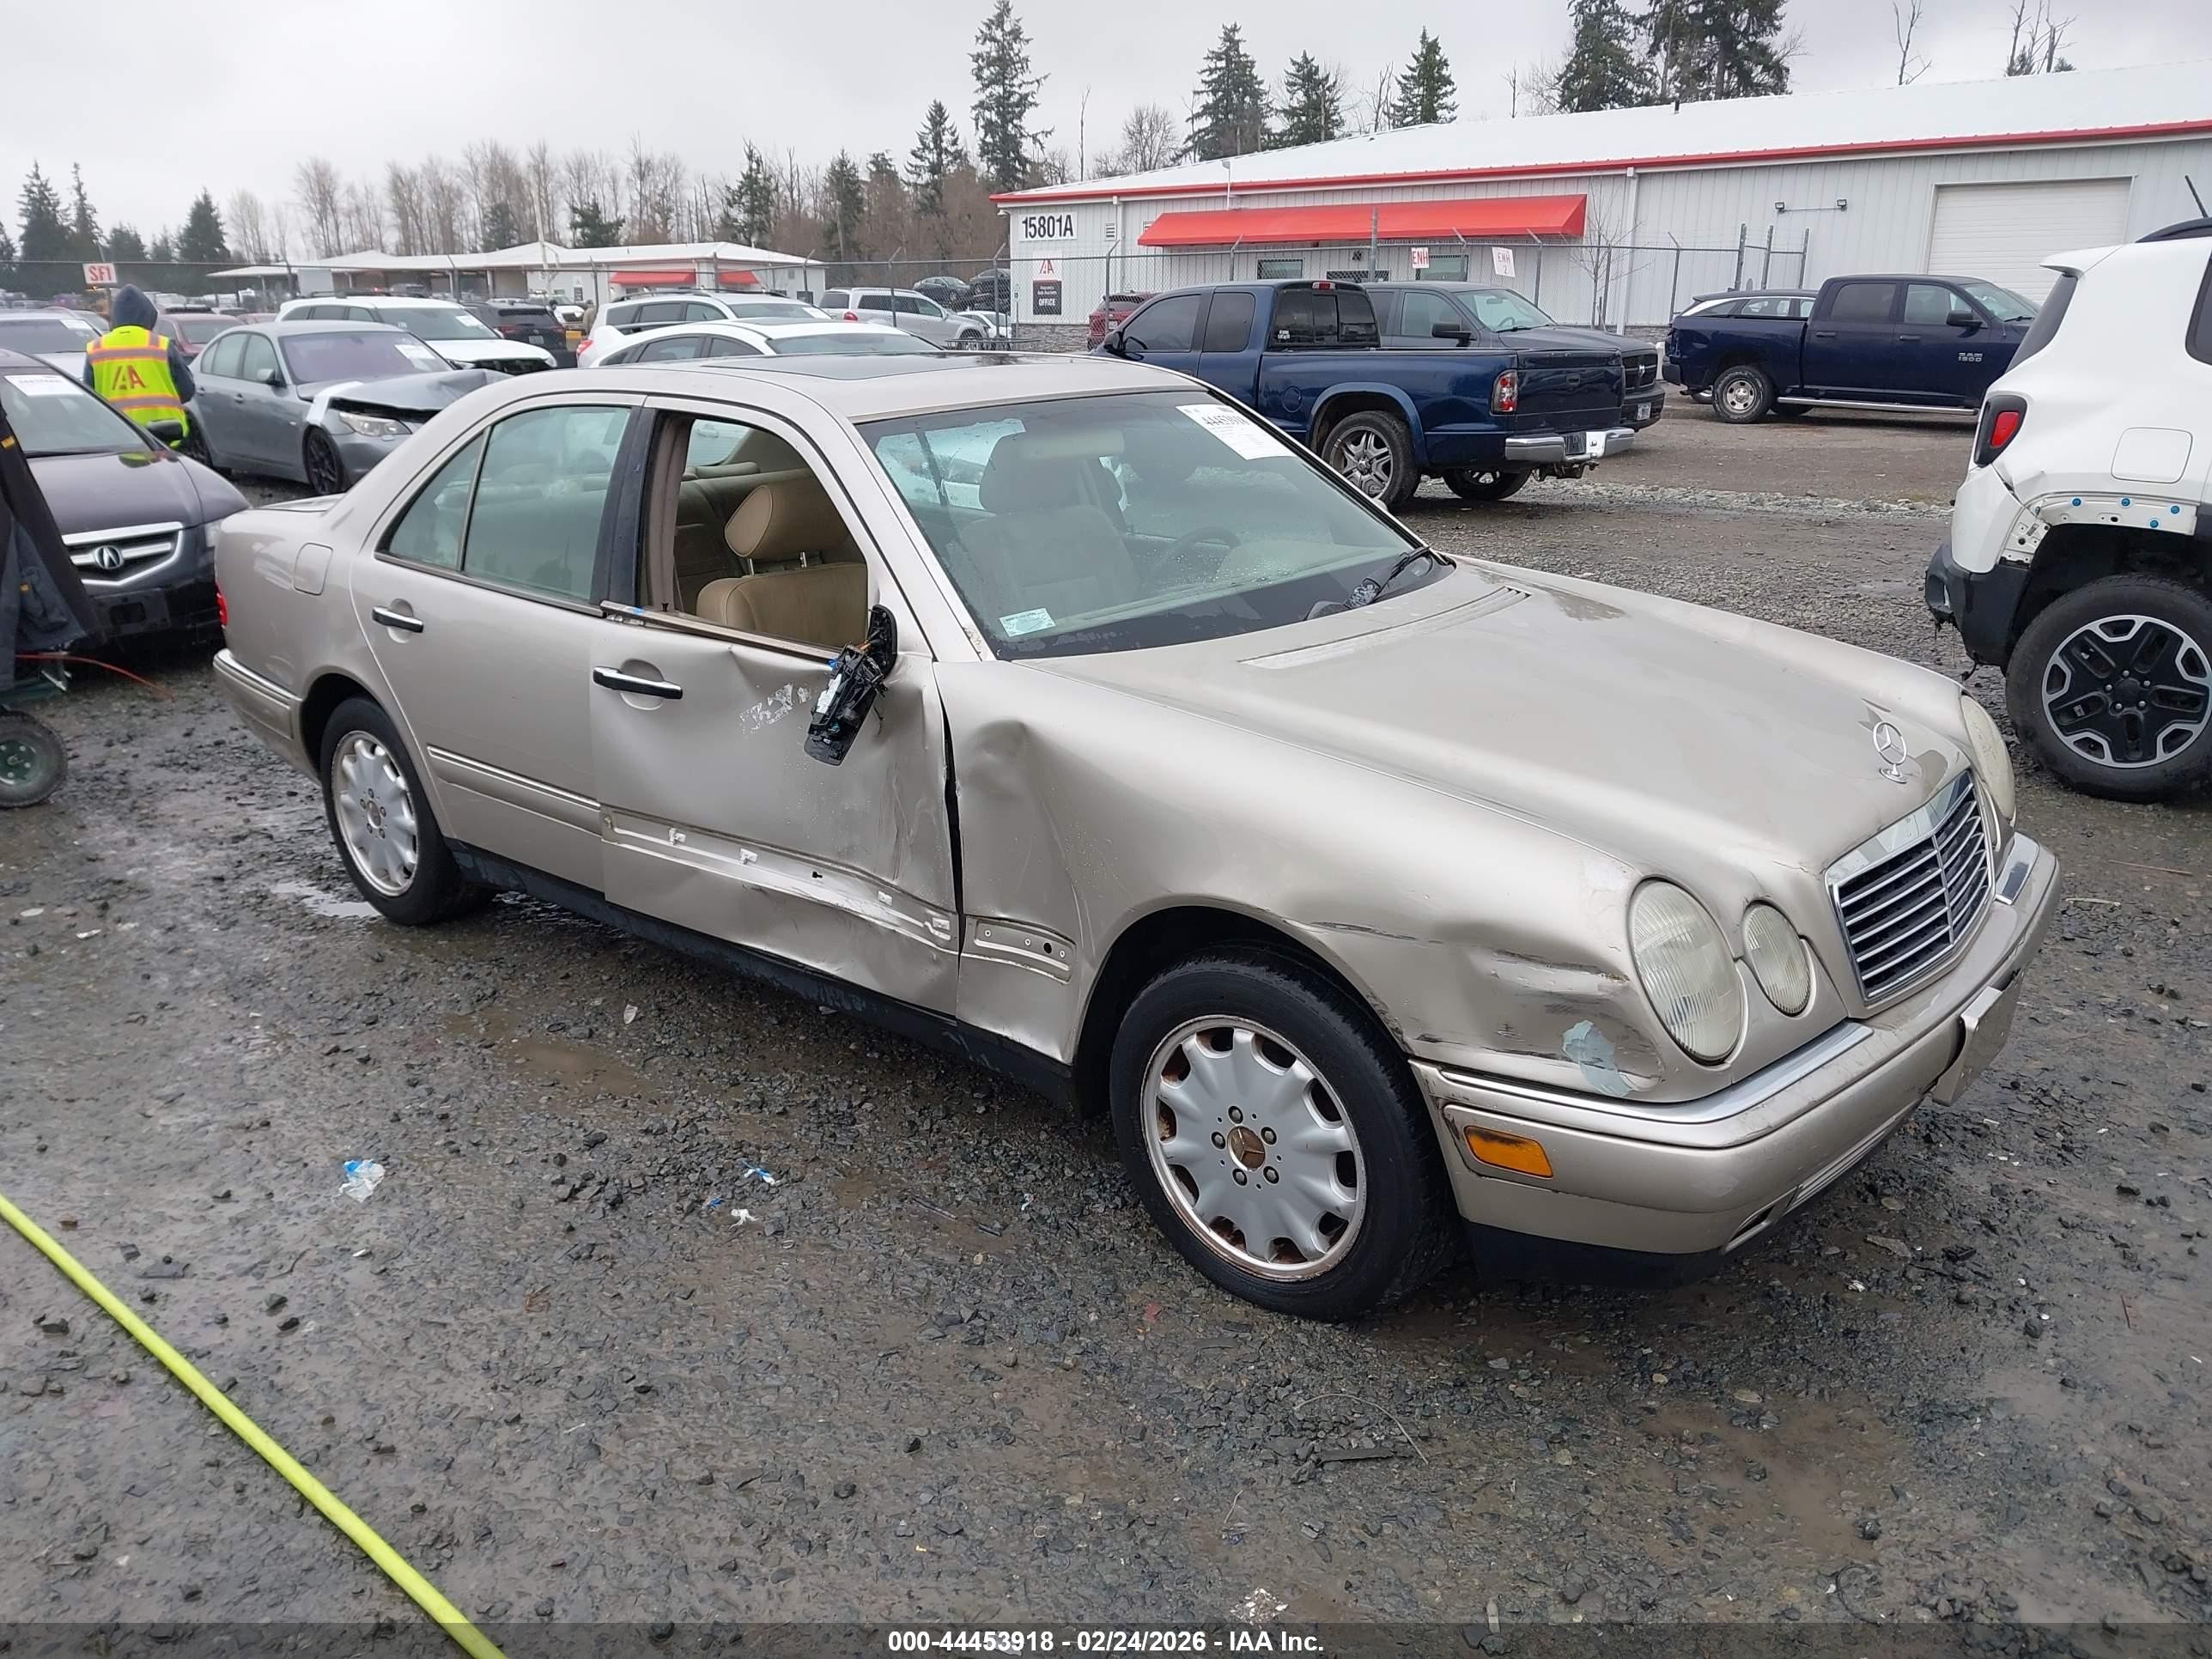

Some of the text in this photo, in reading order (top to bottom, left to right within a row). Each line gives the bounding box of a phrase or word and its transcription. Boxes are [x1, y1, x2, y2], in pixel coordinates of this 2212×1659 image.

[1022, 214, 1073, 239] 15801A
[1413, 251, 1429, 265] ENH
[1038, 298, 1056, 307] OFFICE
